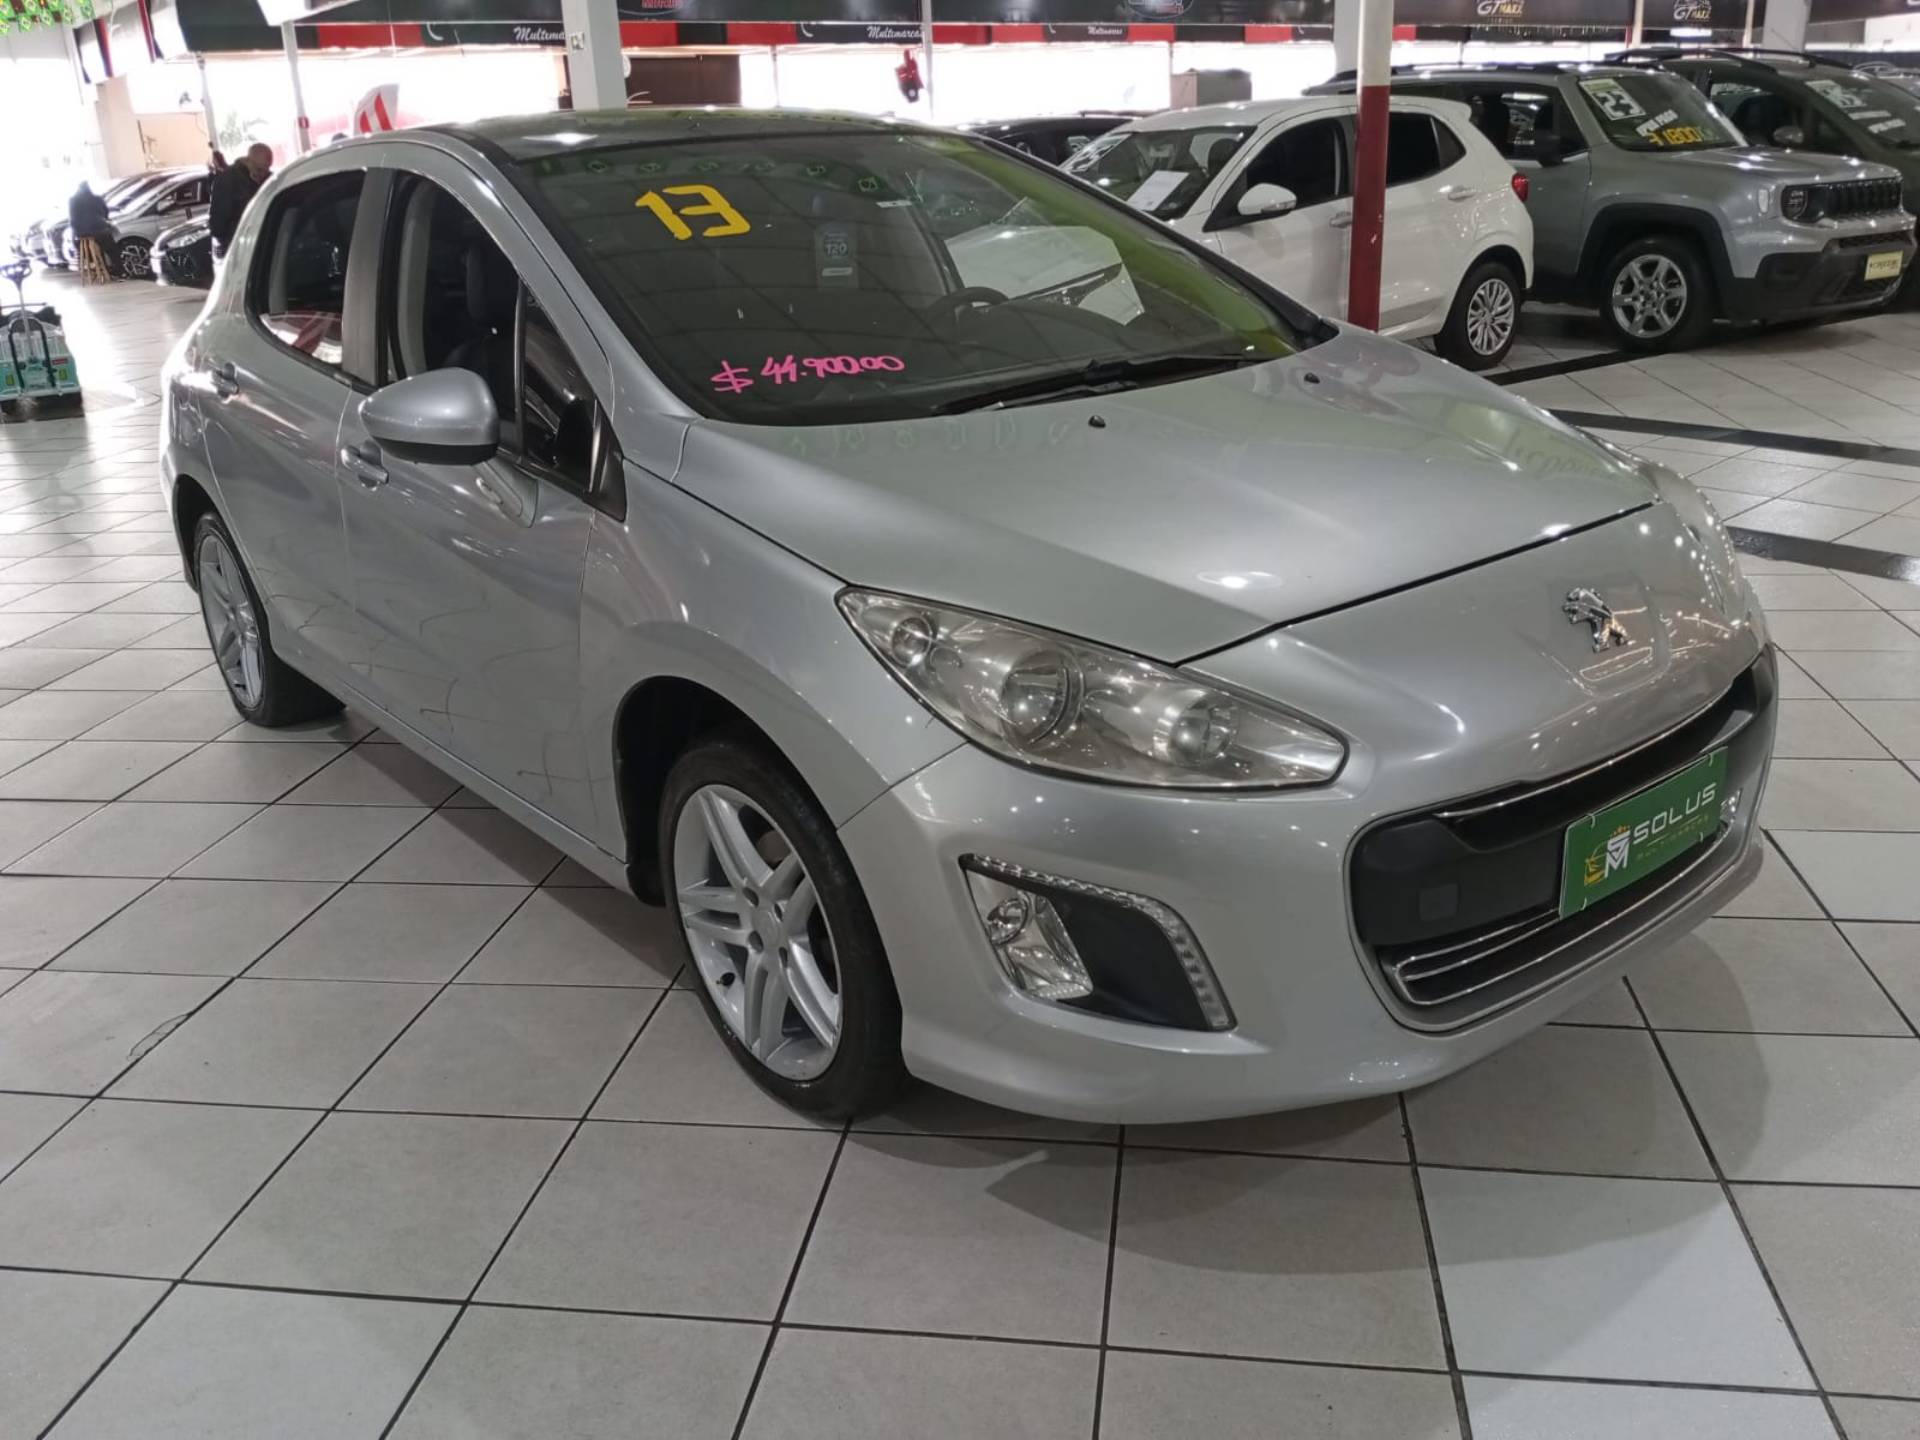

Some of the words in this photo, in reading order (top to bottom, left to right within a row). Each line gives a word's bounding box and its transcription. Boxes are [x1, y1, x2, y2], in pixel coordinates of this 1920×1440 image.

[513, 26, 567, 41] Multima
[635, 185, 751, 240] 13
[1633, 782, 1717, 845] SOLUS
